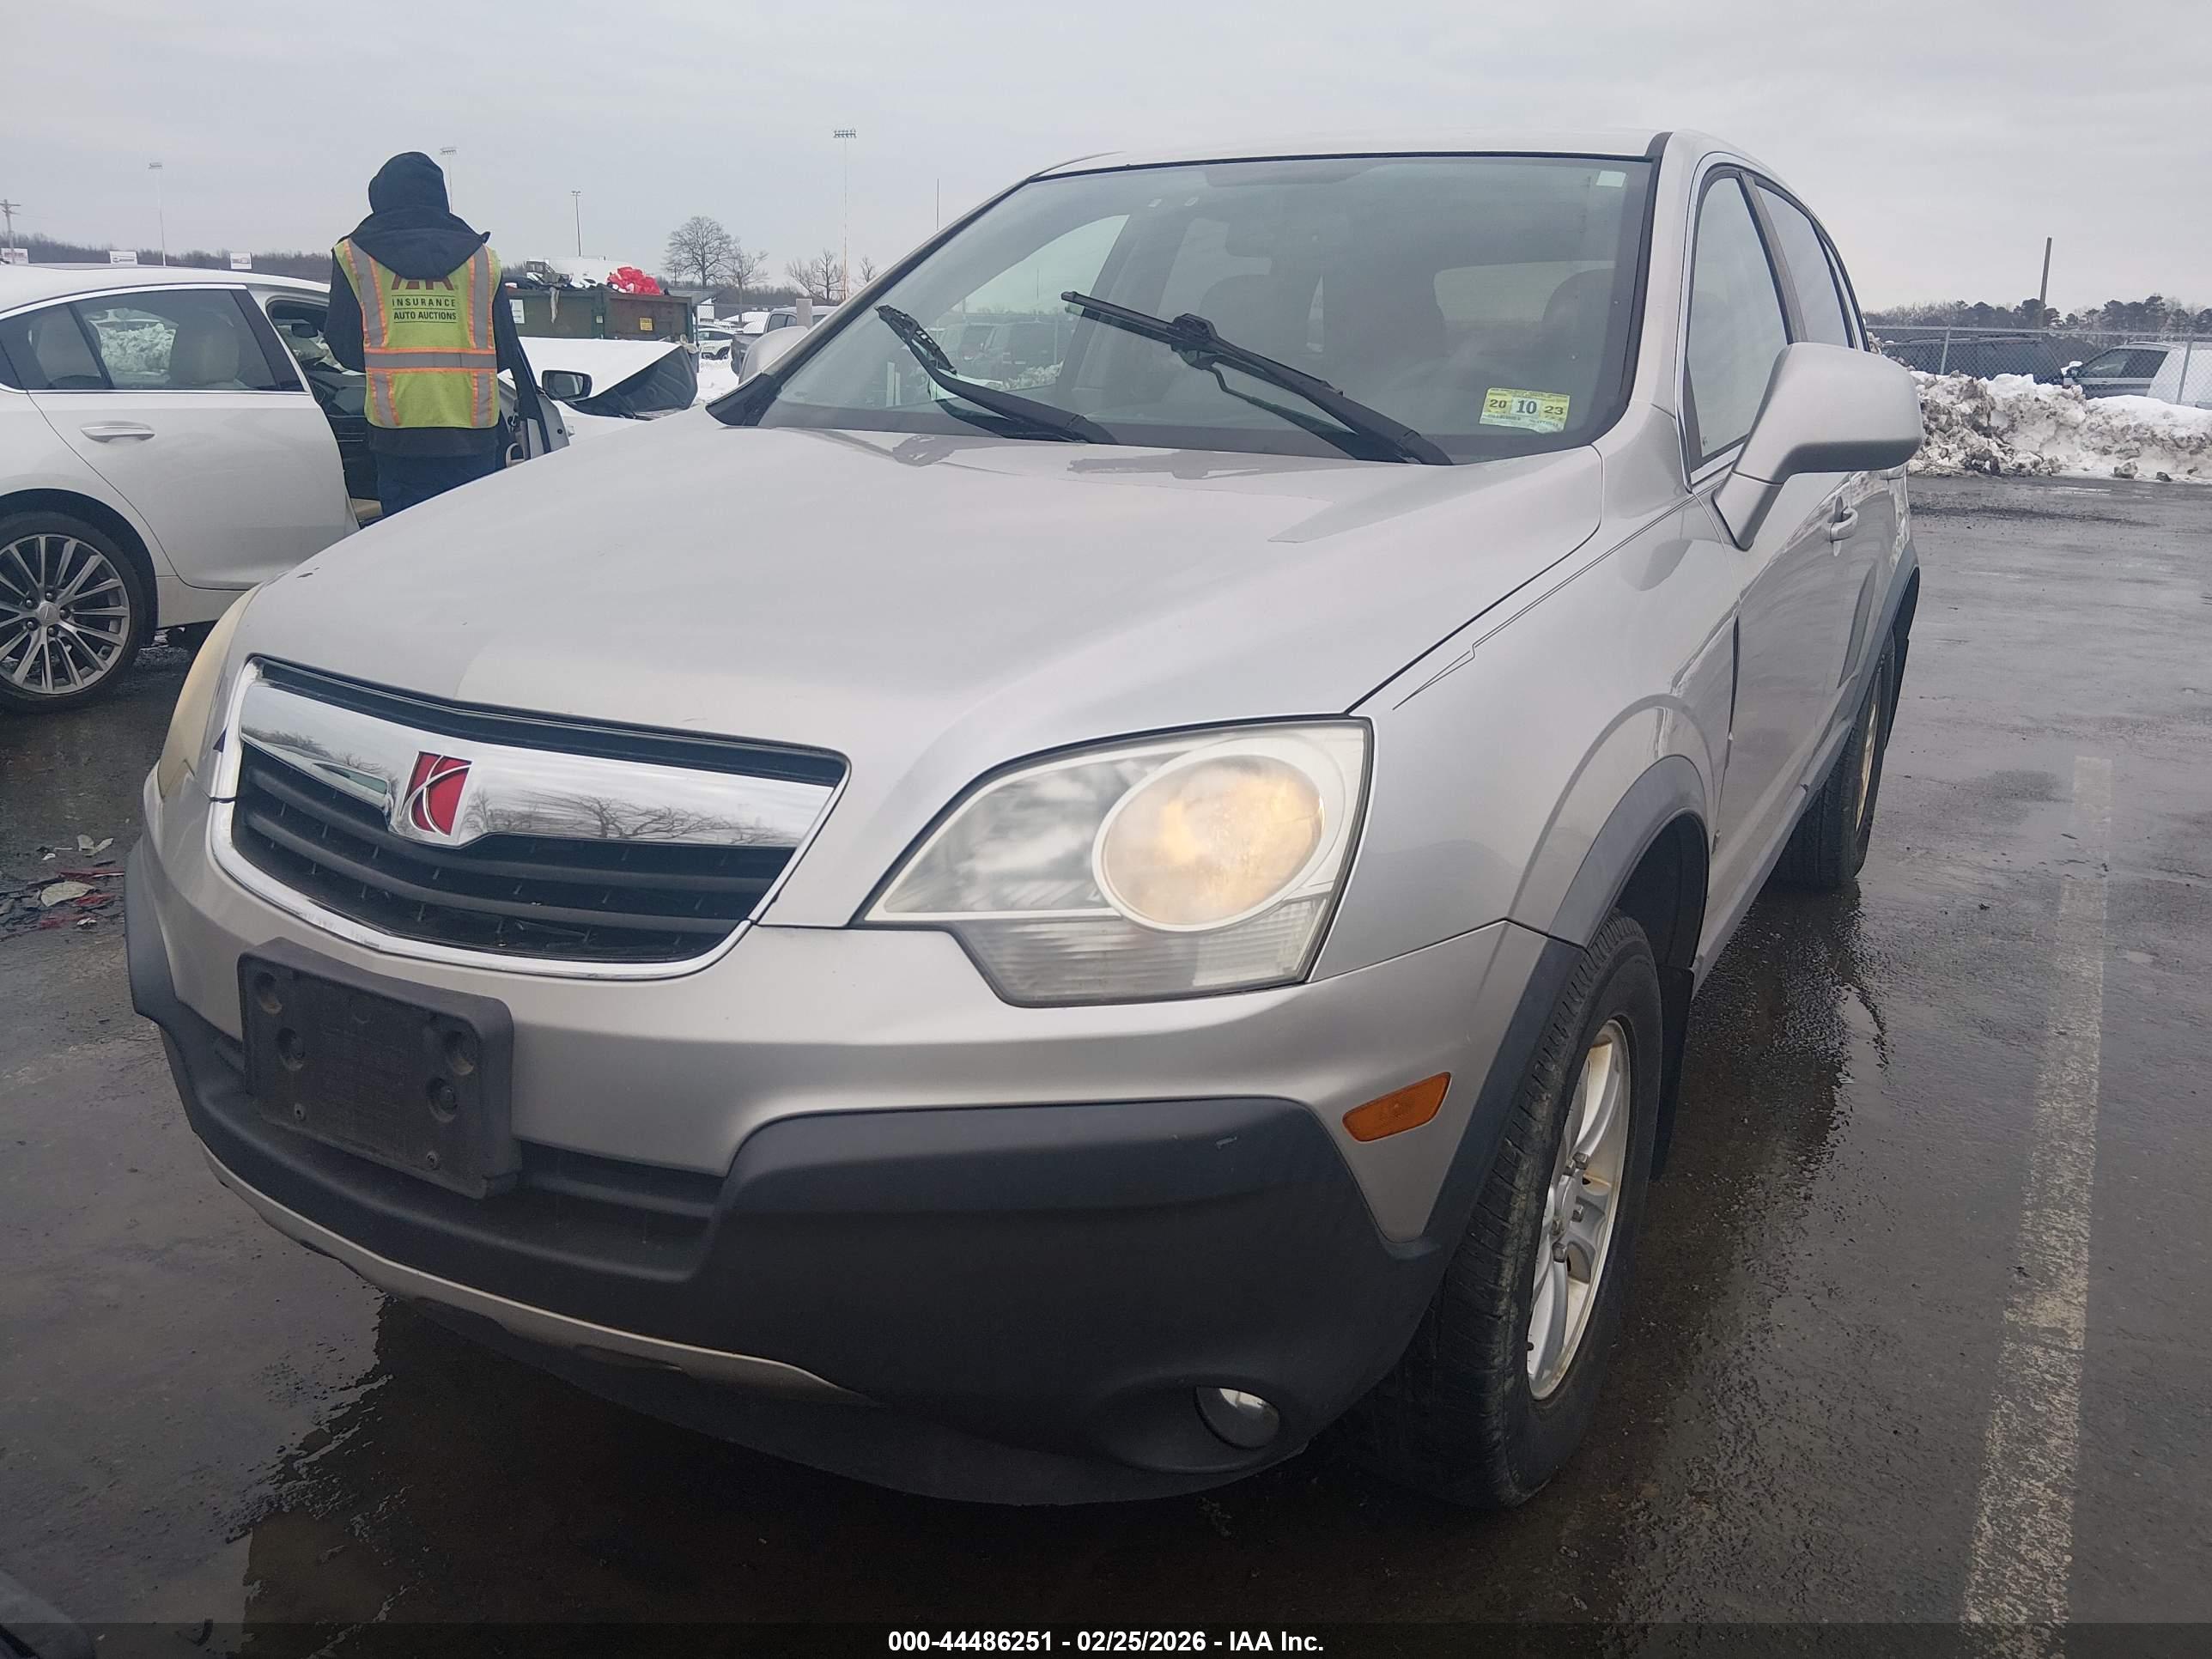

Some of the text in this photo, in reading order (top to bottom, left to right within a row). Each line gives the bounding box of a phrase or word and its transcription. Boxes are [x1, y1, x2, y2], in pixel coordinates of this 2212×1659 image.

[392, 298, 455, 307] INSURANCE
[394, 311, 456, 320] AUTO AUCTIONS
[1489, 398, 1564, 416] 20 10 23
